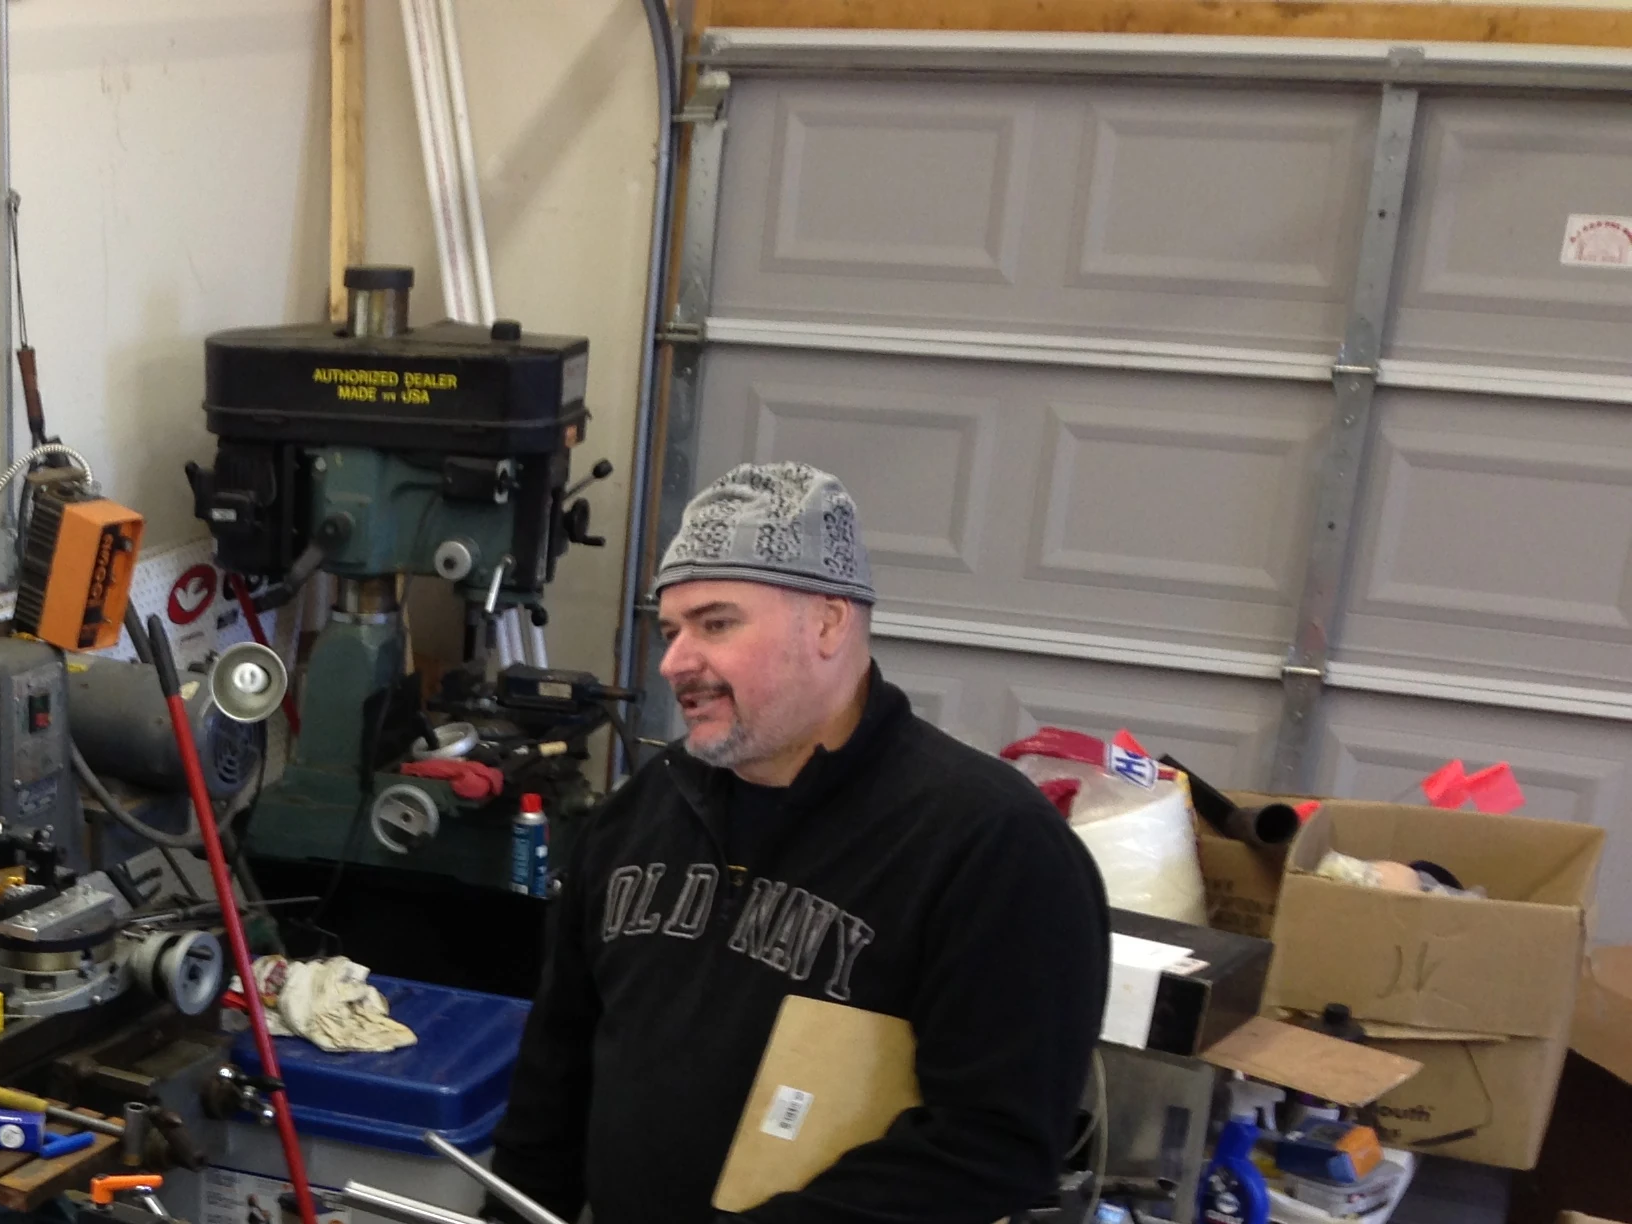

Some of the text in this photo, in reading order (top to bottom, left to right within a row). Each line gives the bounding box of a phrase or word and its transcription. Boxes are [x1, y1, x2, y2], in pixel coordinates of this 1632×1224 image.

[313, 367, 457, 390] AUTHORIZED DEALER
[337, 385, 377, 402] MADE
[401, 388, 430, 404] USA
[602, 863, 875, 1000] OLD NAVY
